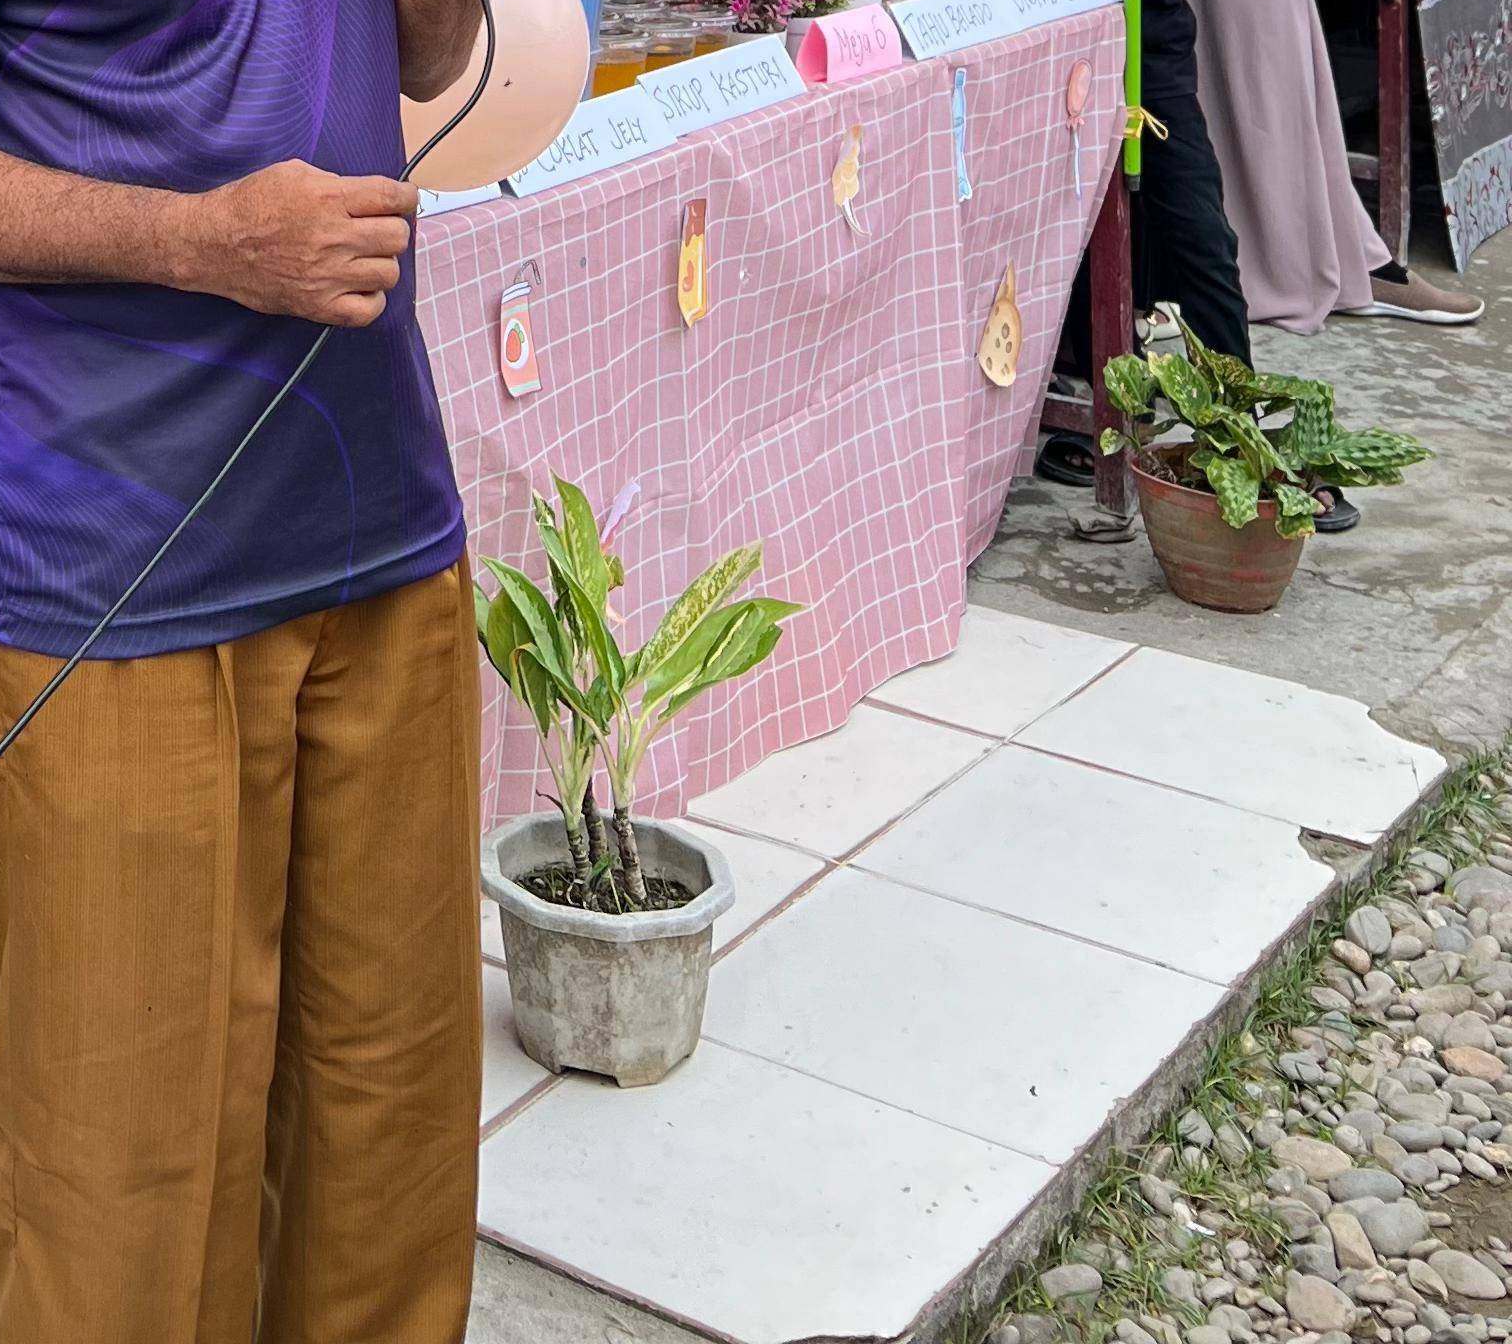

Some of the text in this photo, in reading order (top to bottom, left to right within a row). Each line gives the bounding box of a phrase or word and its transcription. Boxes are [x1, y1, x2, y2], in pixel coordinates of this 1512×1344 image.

[834, 26, 870, 66] Meja
[903, 12, 950, 50] TAHU
[653, 57, 788, 122] SIRUP KASTURI
[608, 118, 648, 150] JELY
